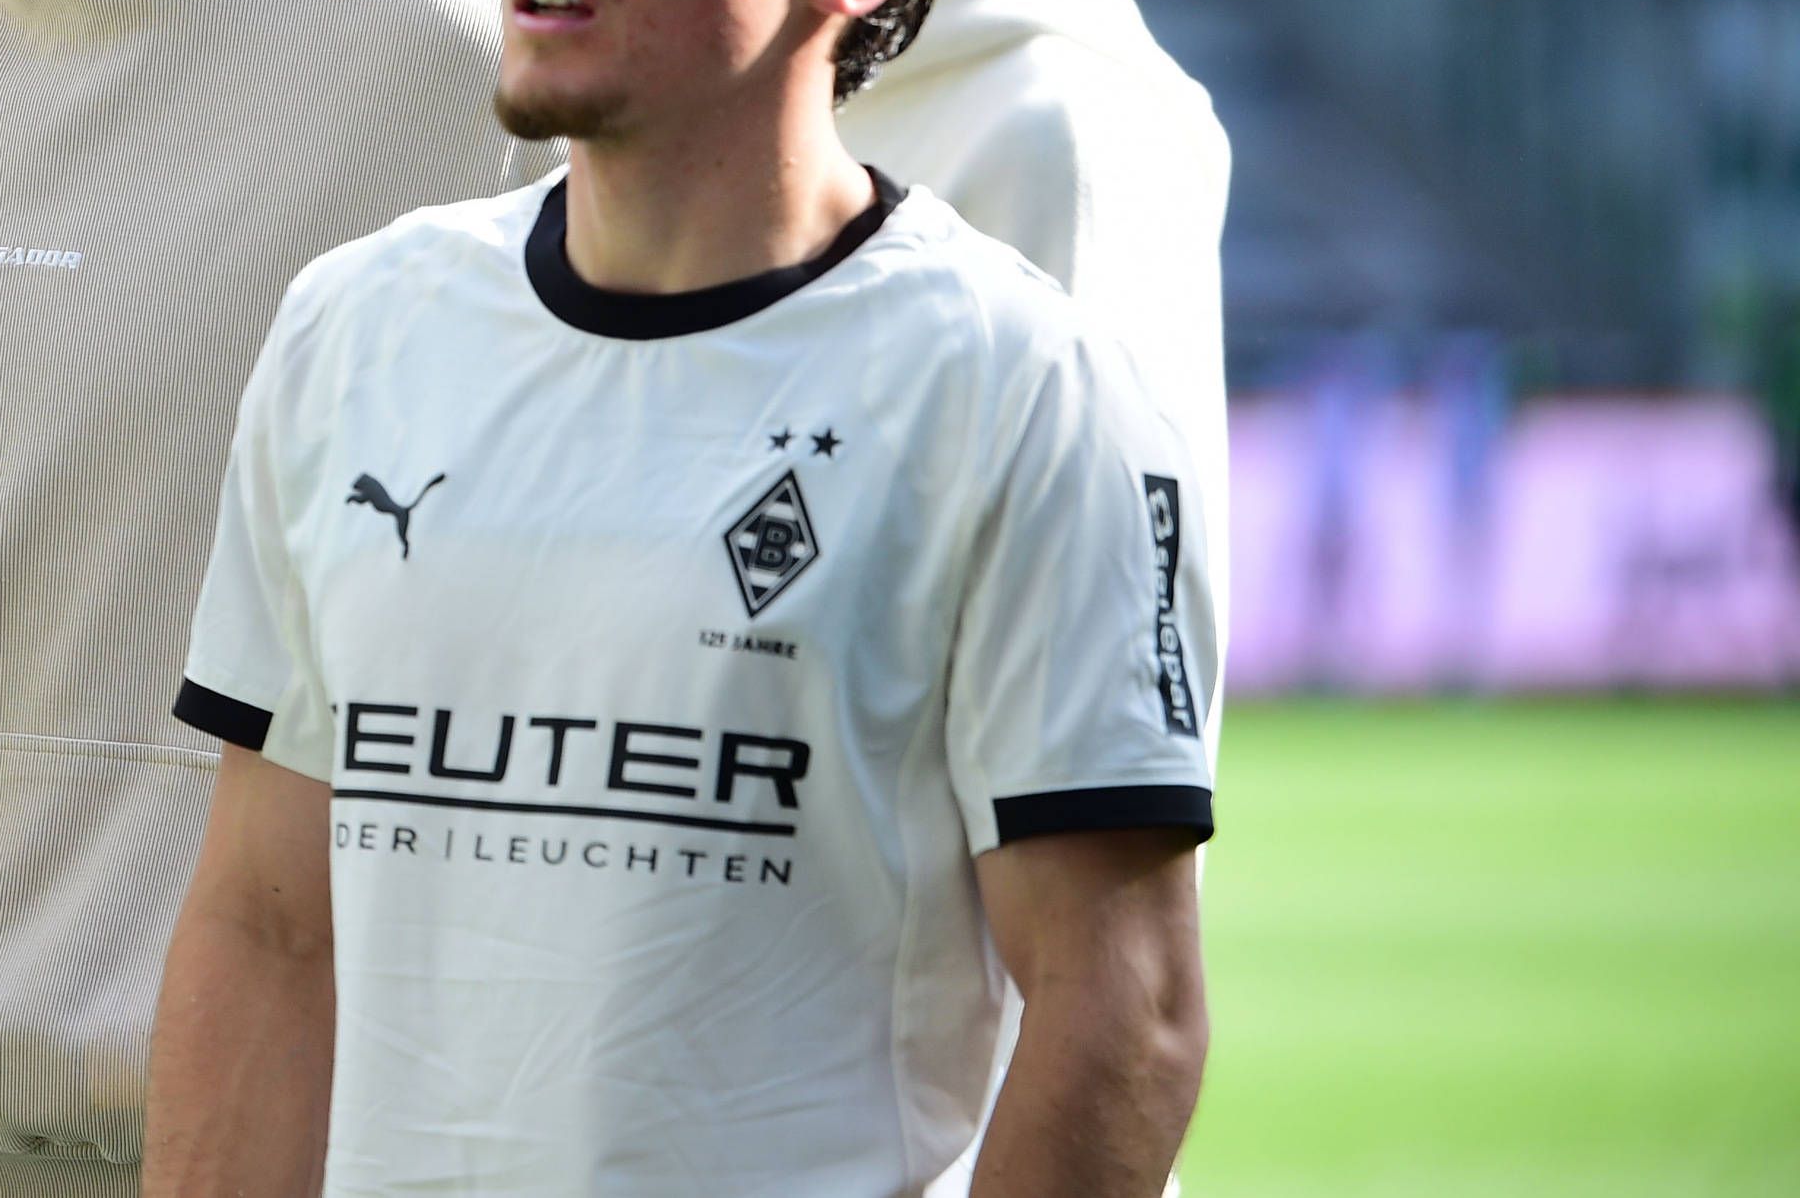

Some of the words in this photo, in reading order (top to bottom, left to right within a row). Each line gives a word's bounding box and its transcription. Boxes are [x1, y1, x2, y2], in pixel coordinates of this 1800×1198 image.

[754, 518, 799, 572] B
[331, 702, 811, 810] EUTER
[335, 823, 417, 855] DER
[474, 834, 792, 886] LEUCHTEN
